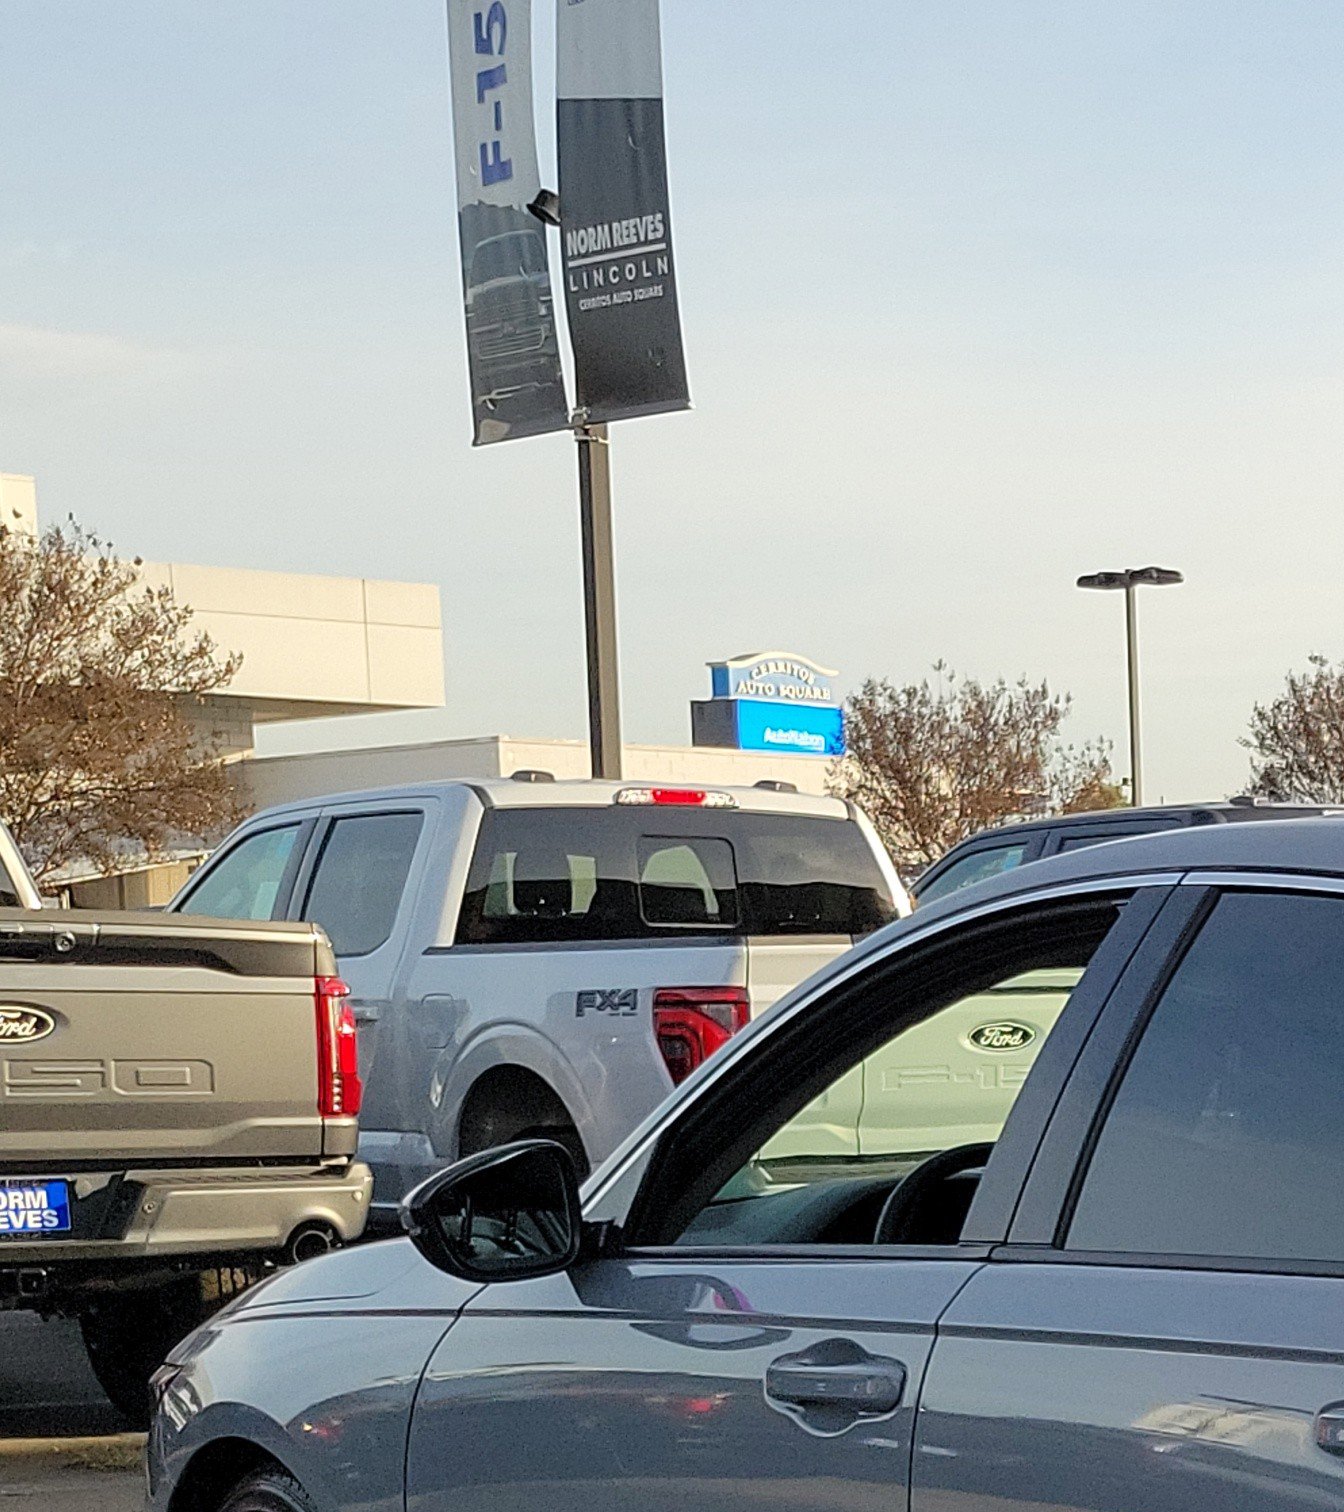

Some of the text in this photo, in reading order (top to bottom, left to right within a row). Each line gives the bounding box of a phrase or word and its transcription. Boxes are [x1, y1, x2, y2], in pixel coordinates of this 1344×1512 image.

[567, 212, 665, 256] NORM REEVES
[569, 256, 669, 292] LINCOLN
[737, 681, 775, 695] AUTO
[576, 989, 638, 1017] FX4
[979, 1026, 1024, 1047] Ford
